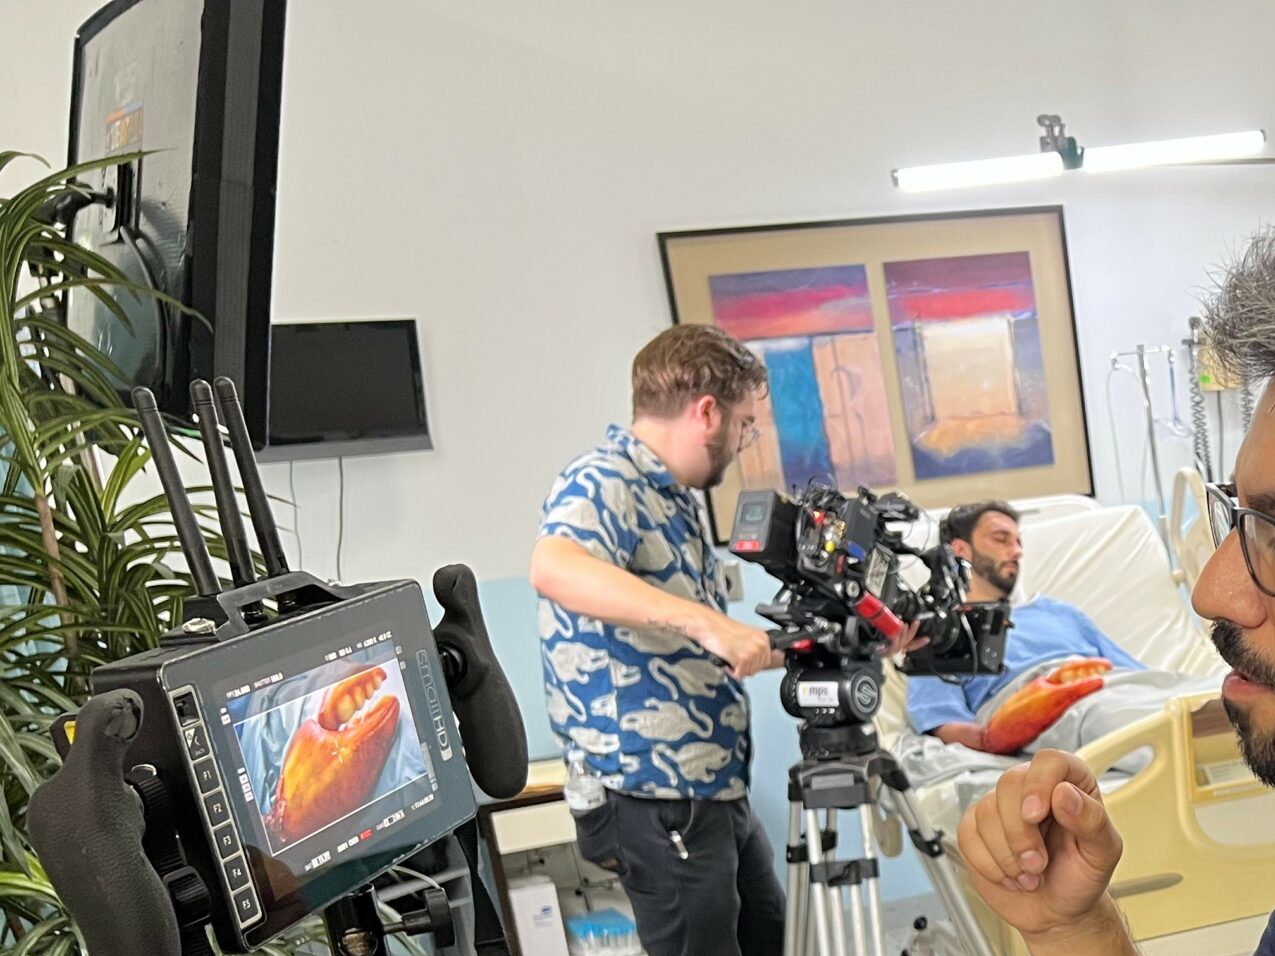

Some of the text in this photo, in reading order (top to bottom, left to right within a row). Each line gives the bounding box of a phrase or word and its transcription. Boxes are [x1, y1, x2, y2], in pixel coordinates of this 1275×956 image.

[418, 651, 449, 748] smallHD
[203, 770, 212, 781] F1
[213, 803, 223, 813] F2
[223, 835, 232, 846] F3
[232, 867, 242, 878] F4
[242, 899, 251, 910] F5
